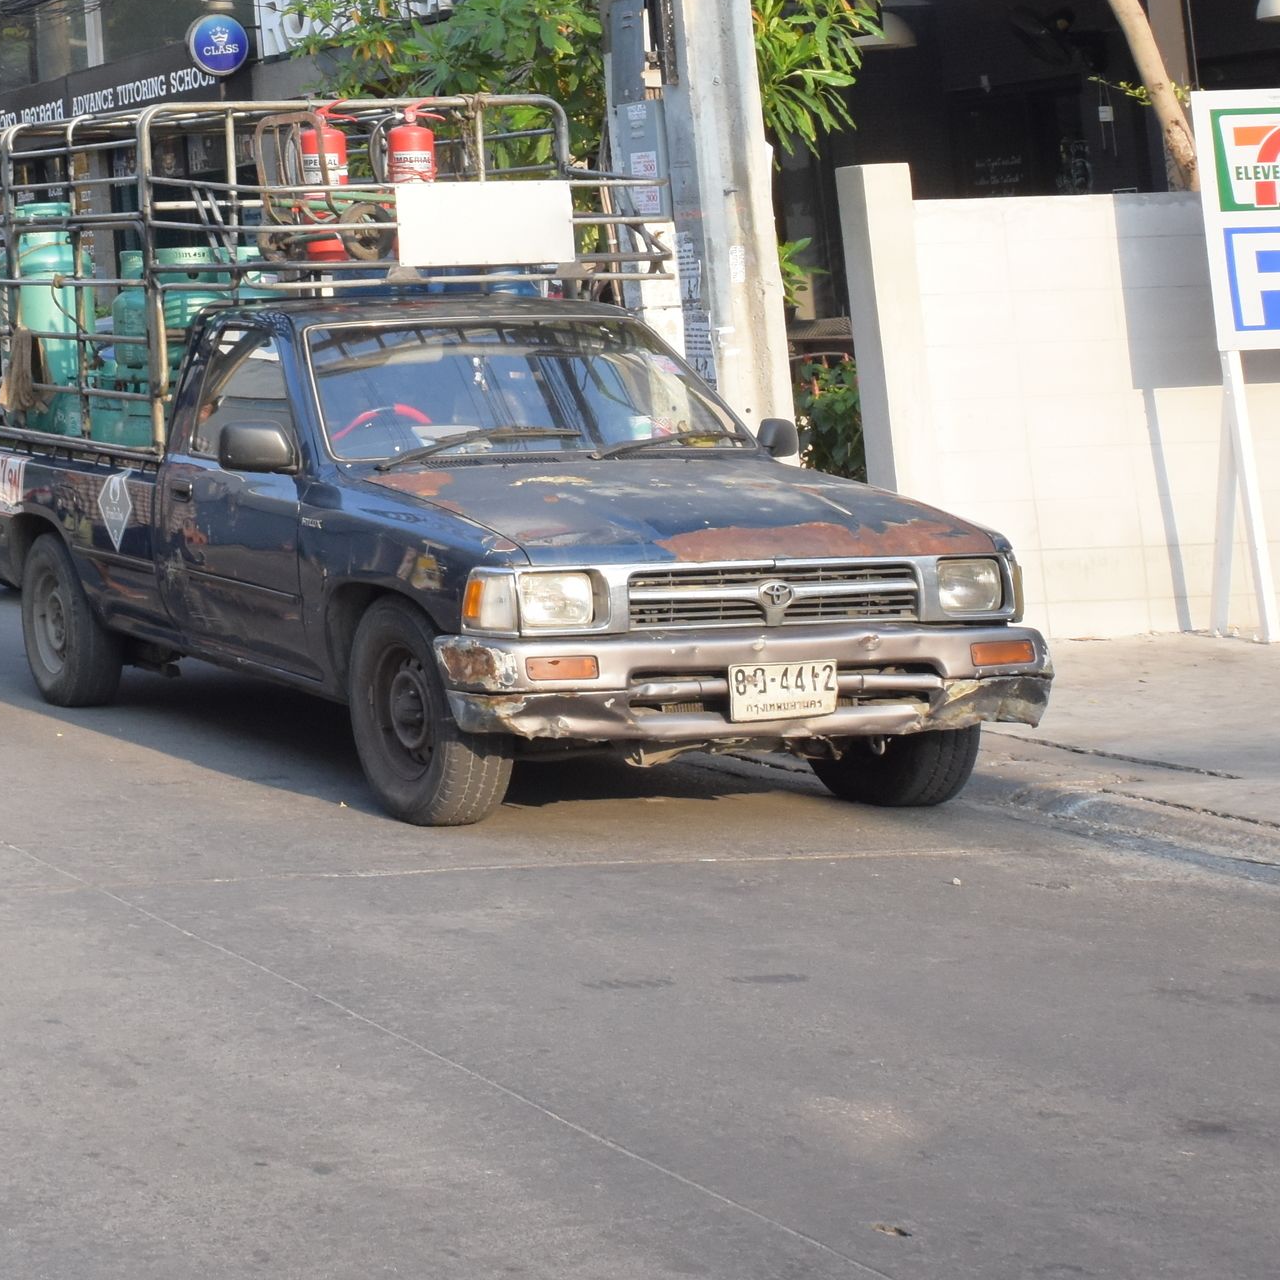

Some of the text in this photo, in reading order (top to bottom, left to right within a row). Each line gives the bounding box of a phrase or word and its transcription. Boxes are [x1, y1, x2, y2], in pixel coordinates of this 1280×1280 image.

[203, 43, 240, 56] CLASS
[72, 87, 114, 116] ADVANCE
[116, 73, 167, 106] TUTORING
